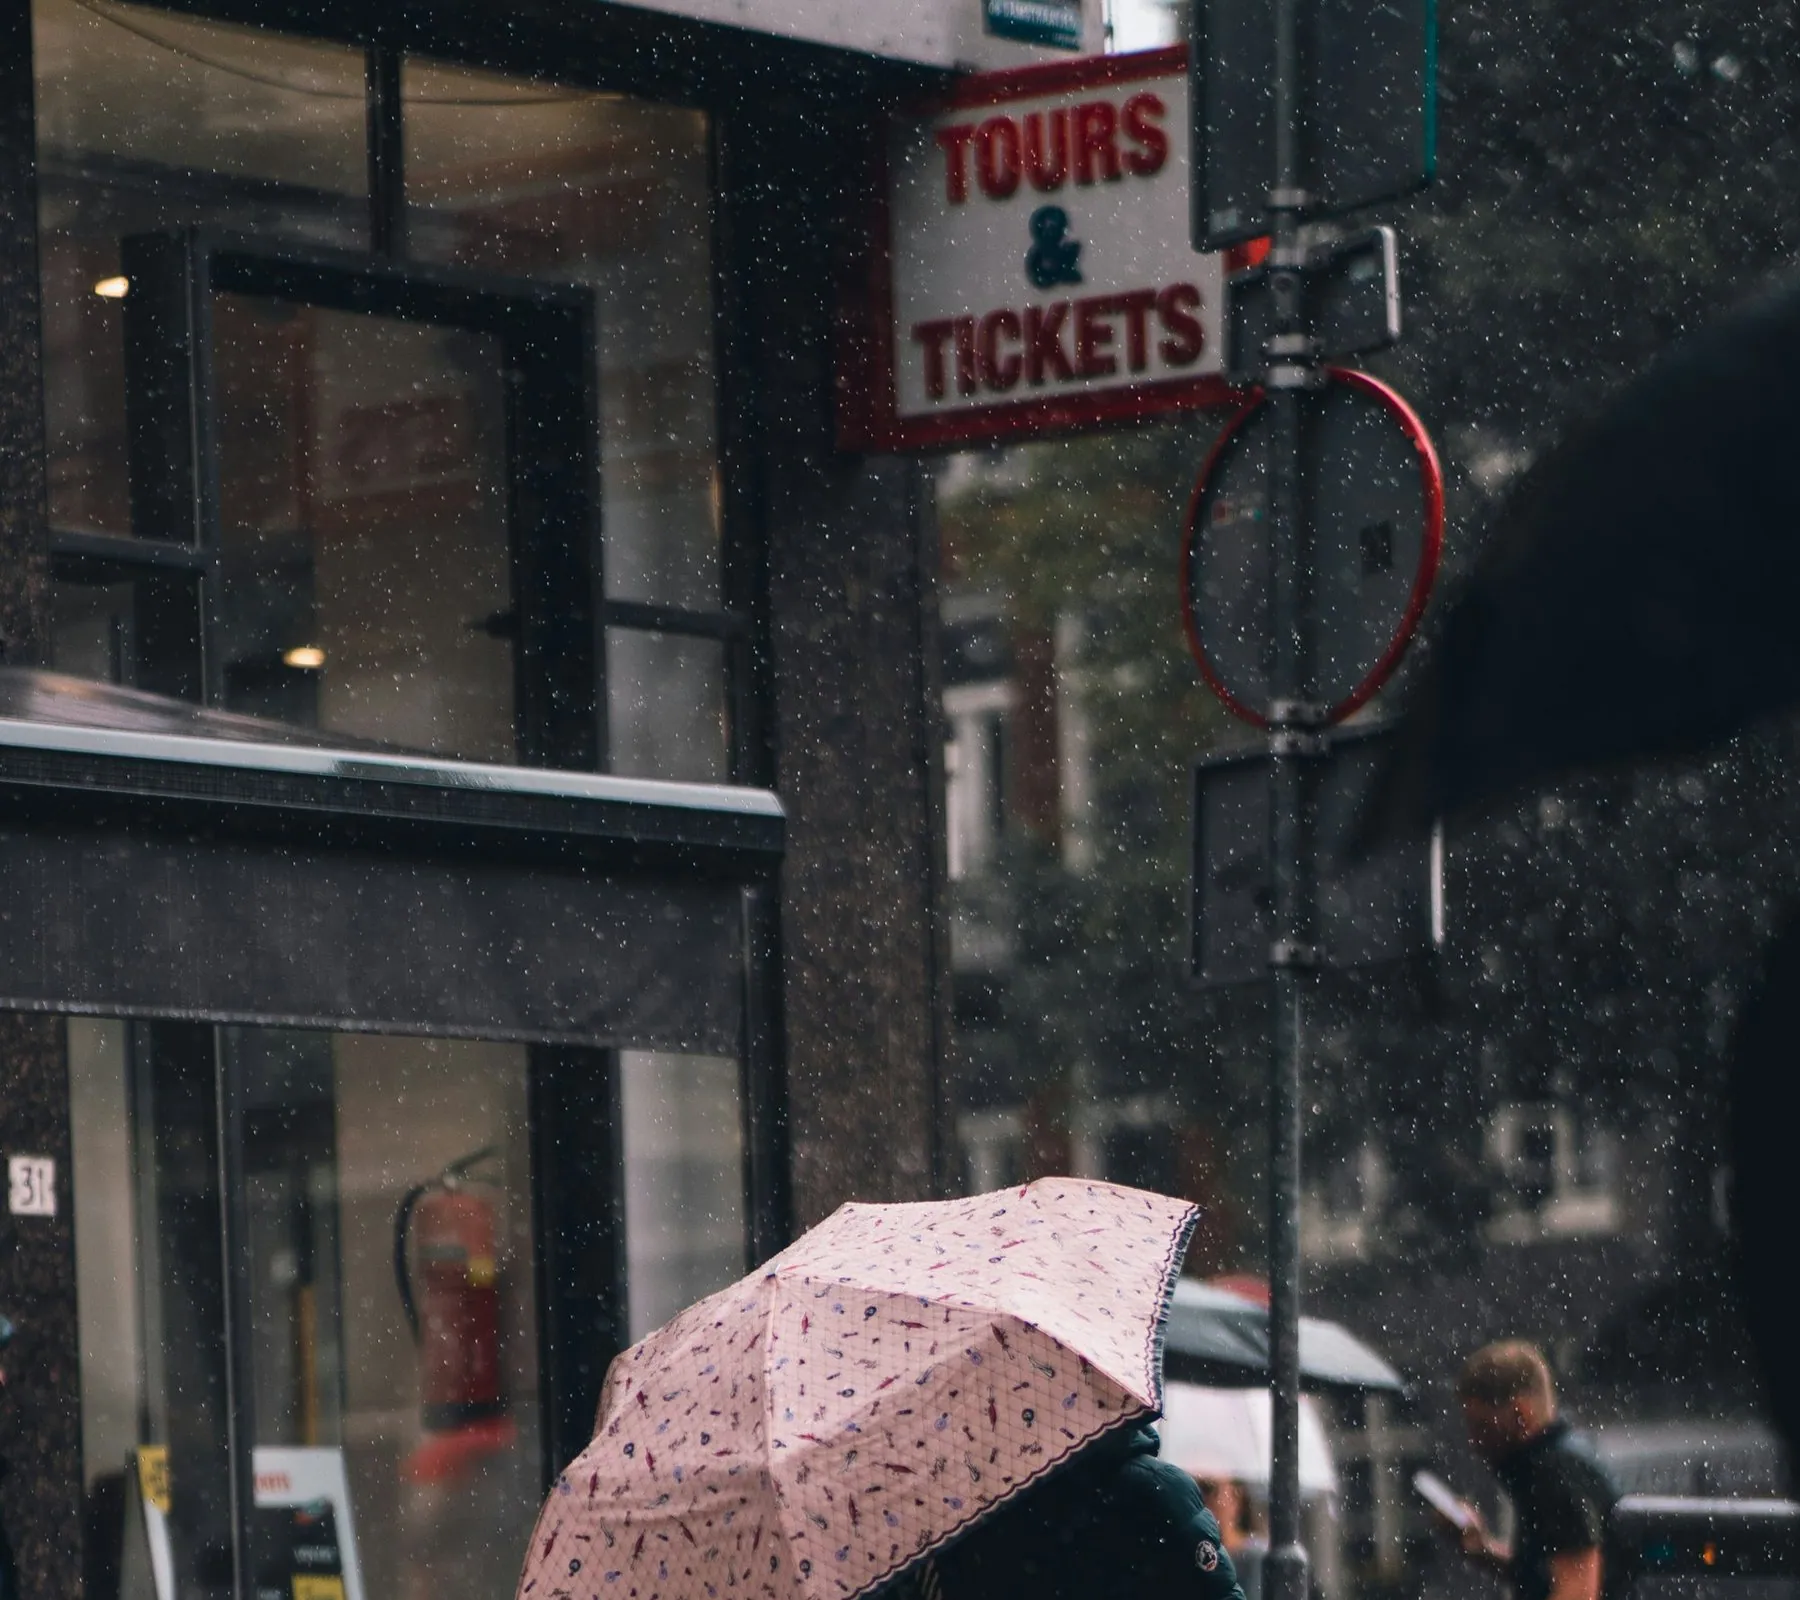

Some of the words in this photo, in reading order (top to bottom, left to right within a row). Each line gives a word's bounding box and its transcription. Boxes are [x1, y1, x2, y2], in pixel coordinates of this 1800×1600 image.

[935, 91, 1170, 206] TOURS
[1025, 205, 1083, 289] &
[910, 282, 1206, 400] TICKETS
[20, 1166, 44, 1208] 31
